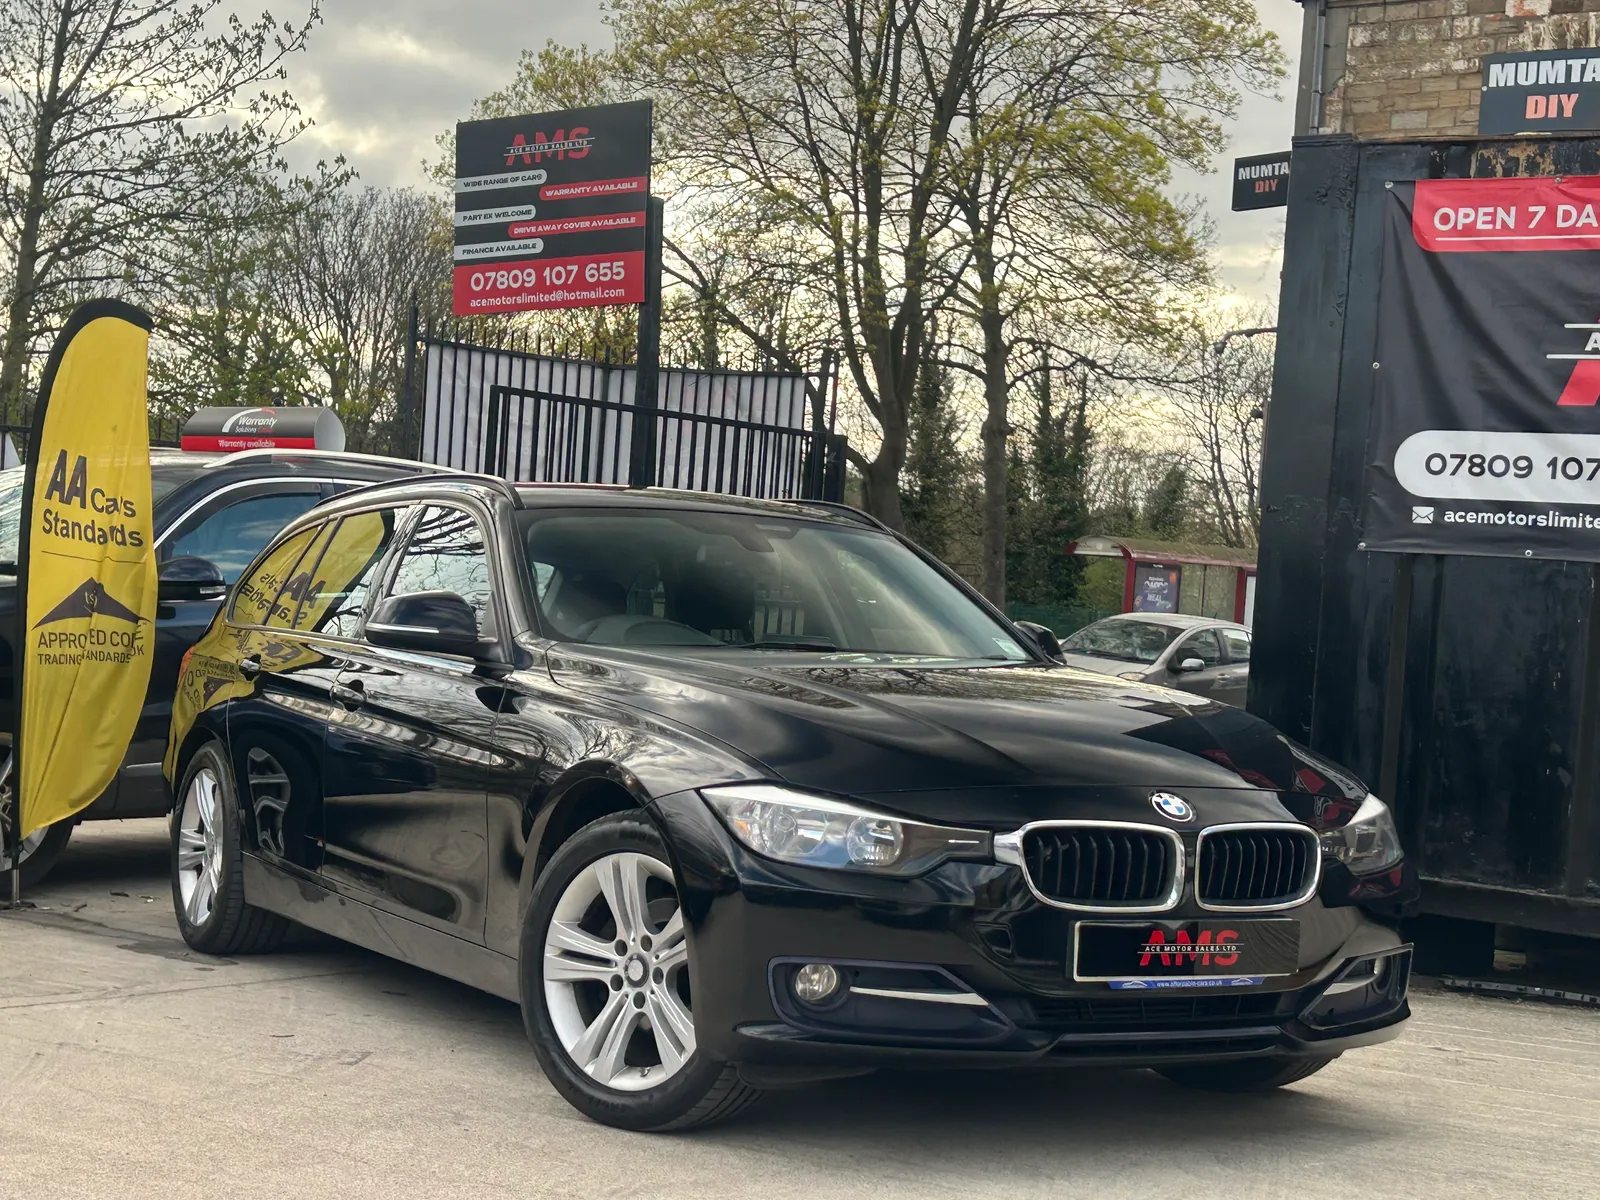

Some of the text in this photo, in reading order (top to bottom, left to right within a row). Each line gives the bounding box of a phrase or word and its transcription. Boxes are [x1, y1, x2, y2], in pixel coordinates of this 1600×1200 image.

[1489, 58, 1600, 87] MUMTA
[1525, 93, 1579, 119] DIY
[506, 127, 590, 166] AMS
[510, 146, 522, 154] ACE
[525, 144, 548, 152] MOTOR
[551, 141, 573, 149] SALES
[463, 180, 482, 188] WIDE
[483, 177, 509, 186] RANGE
[521, 173, 543, 181] CARS
[1238, 161, 1289, 180] MUMTA
[545, 181, 638, 196] WARRANTY AVAILABLE
[1255, 179, 1278, 193] DIY
[462, 208, 533, 222] PART EX WELCOME
[513, 216, 636, 234] DRIVE AWAY COVER AVAILABLE
[1433, 203, 1599, 231] OPEN 7 DA
[462, 242, 537, 256] FINANCE AVAILABLE
[470, 261, 625, 292] 07809 107 655
[470, 287, 625, 308] acemotorslimited@hotmail.com
[238, 416, 278, 428] Warranty
[218, 439, 276, 449] Warranty available
[1425, 452, 1600, 481] 07809 107
[44, 448, 136, 518] AA Cas
[42, 508, 144, 548] Standards
[1444, 510, 1600, 530] acemotorslimite
[37, 628, 107, 649] APPROED
[1139, 929, 1240, 966] AMS
